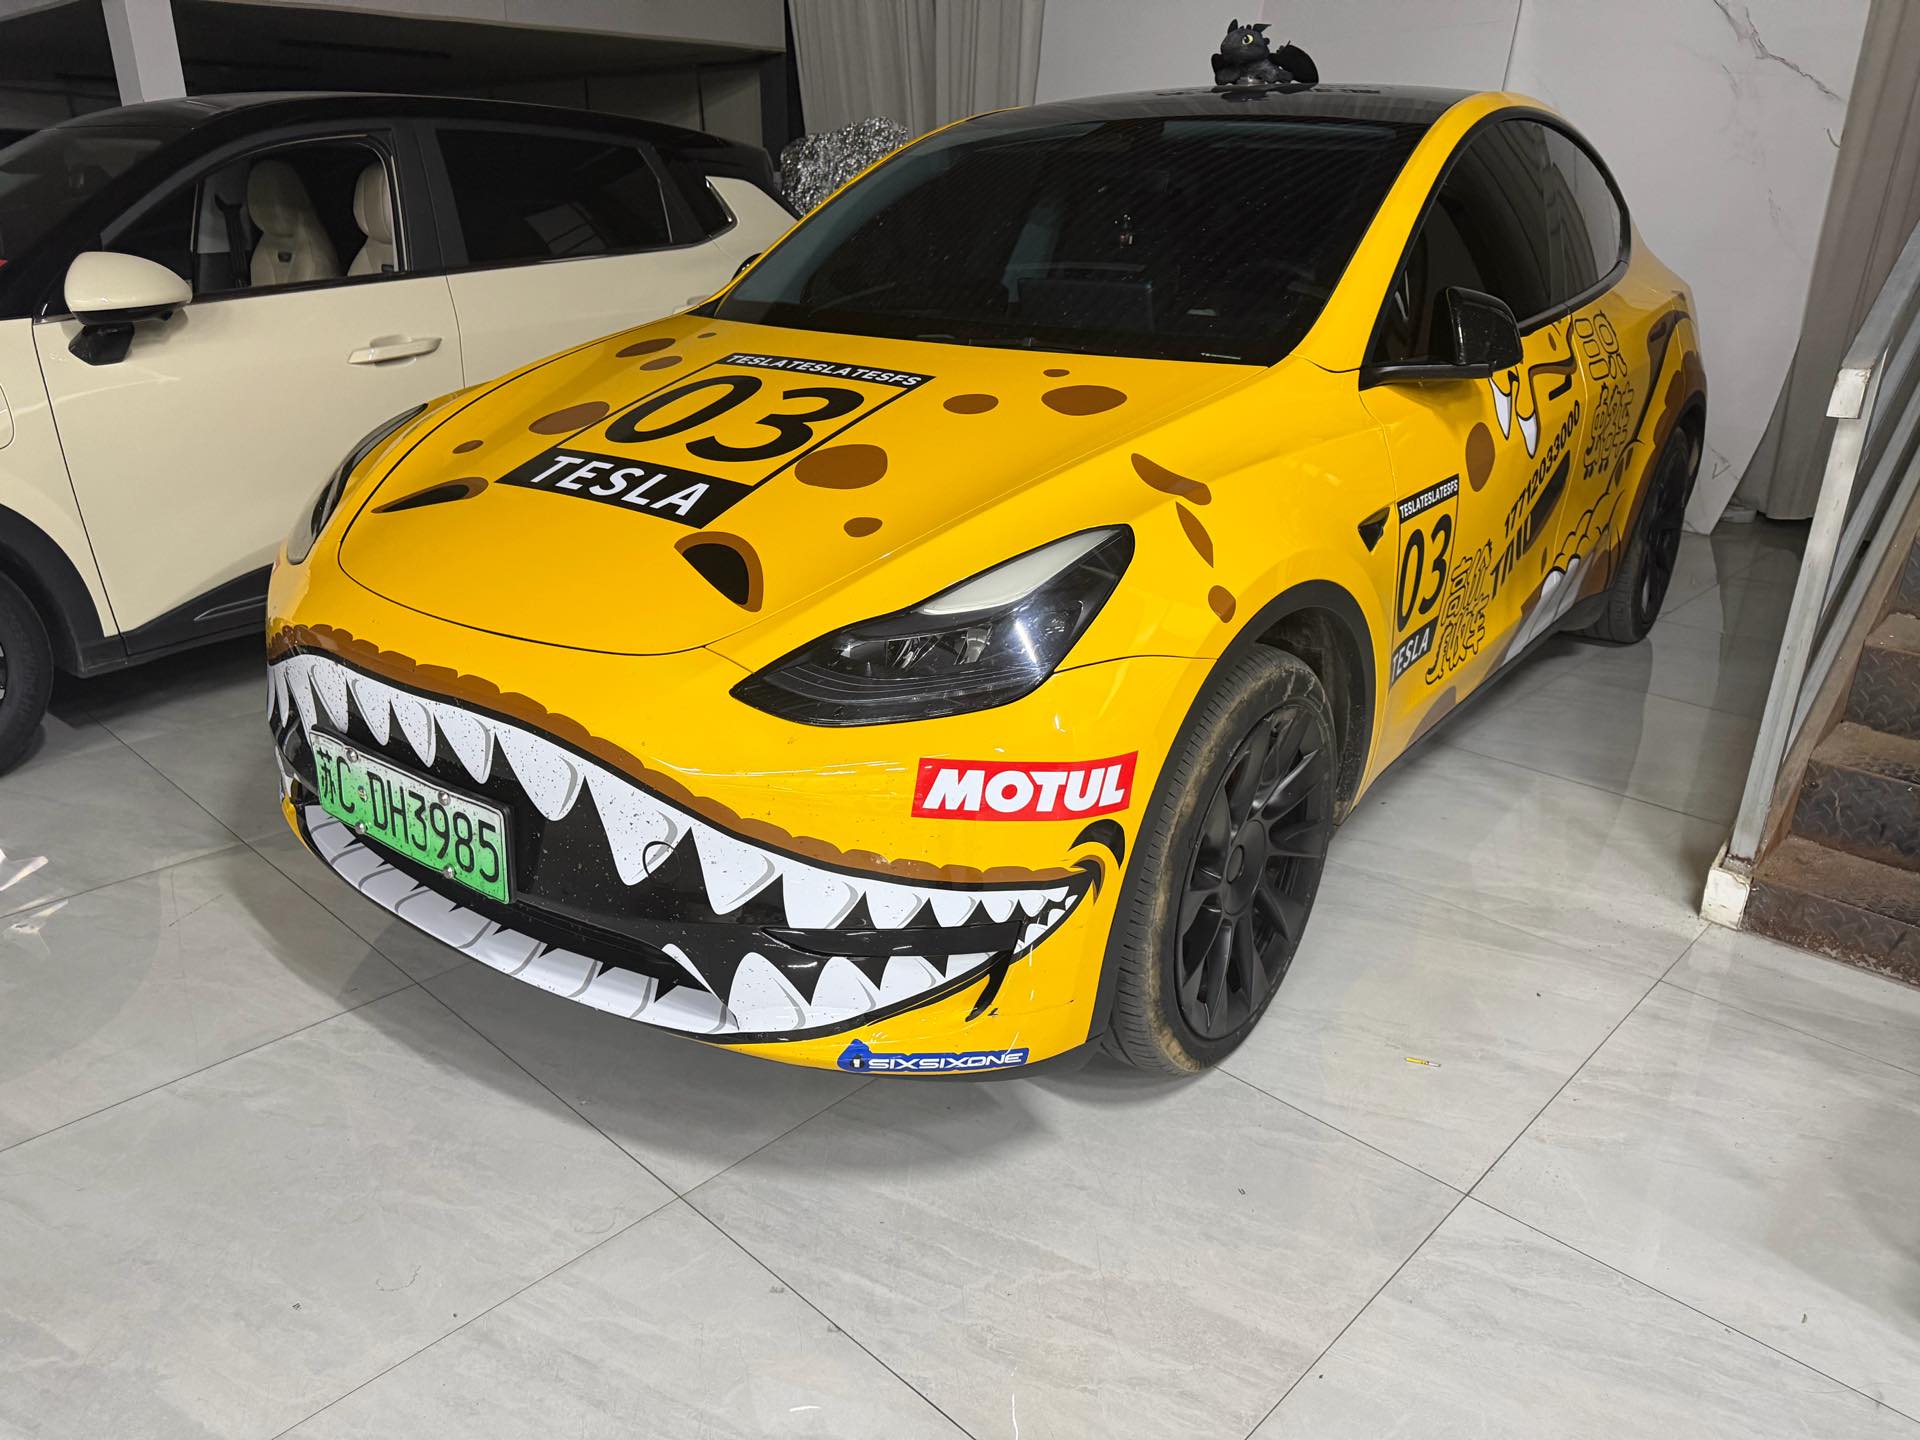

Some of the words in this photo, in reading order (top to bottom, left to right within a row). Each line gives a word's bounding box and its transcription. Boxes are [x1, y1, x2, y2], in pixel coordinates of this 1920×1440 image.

[604, 375, 865, 463] 03
[530, 455, 711, 518] TESLA
[1504, 400, 1580, 538] 17712033000
[1397, 513, 1453, 633] 03
[1391, 627, 1431, 683] TESLA
[921, 764, 1126, 814] MOTUL
[868, 1052, 1024, 1071] SIXSIXONE
